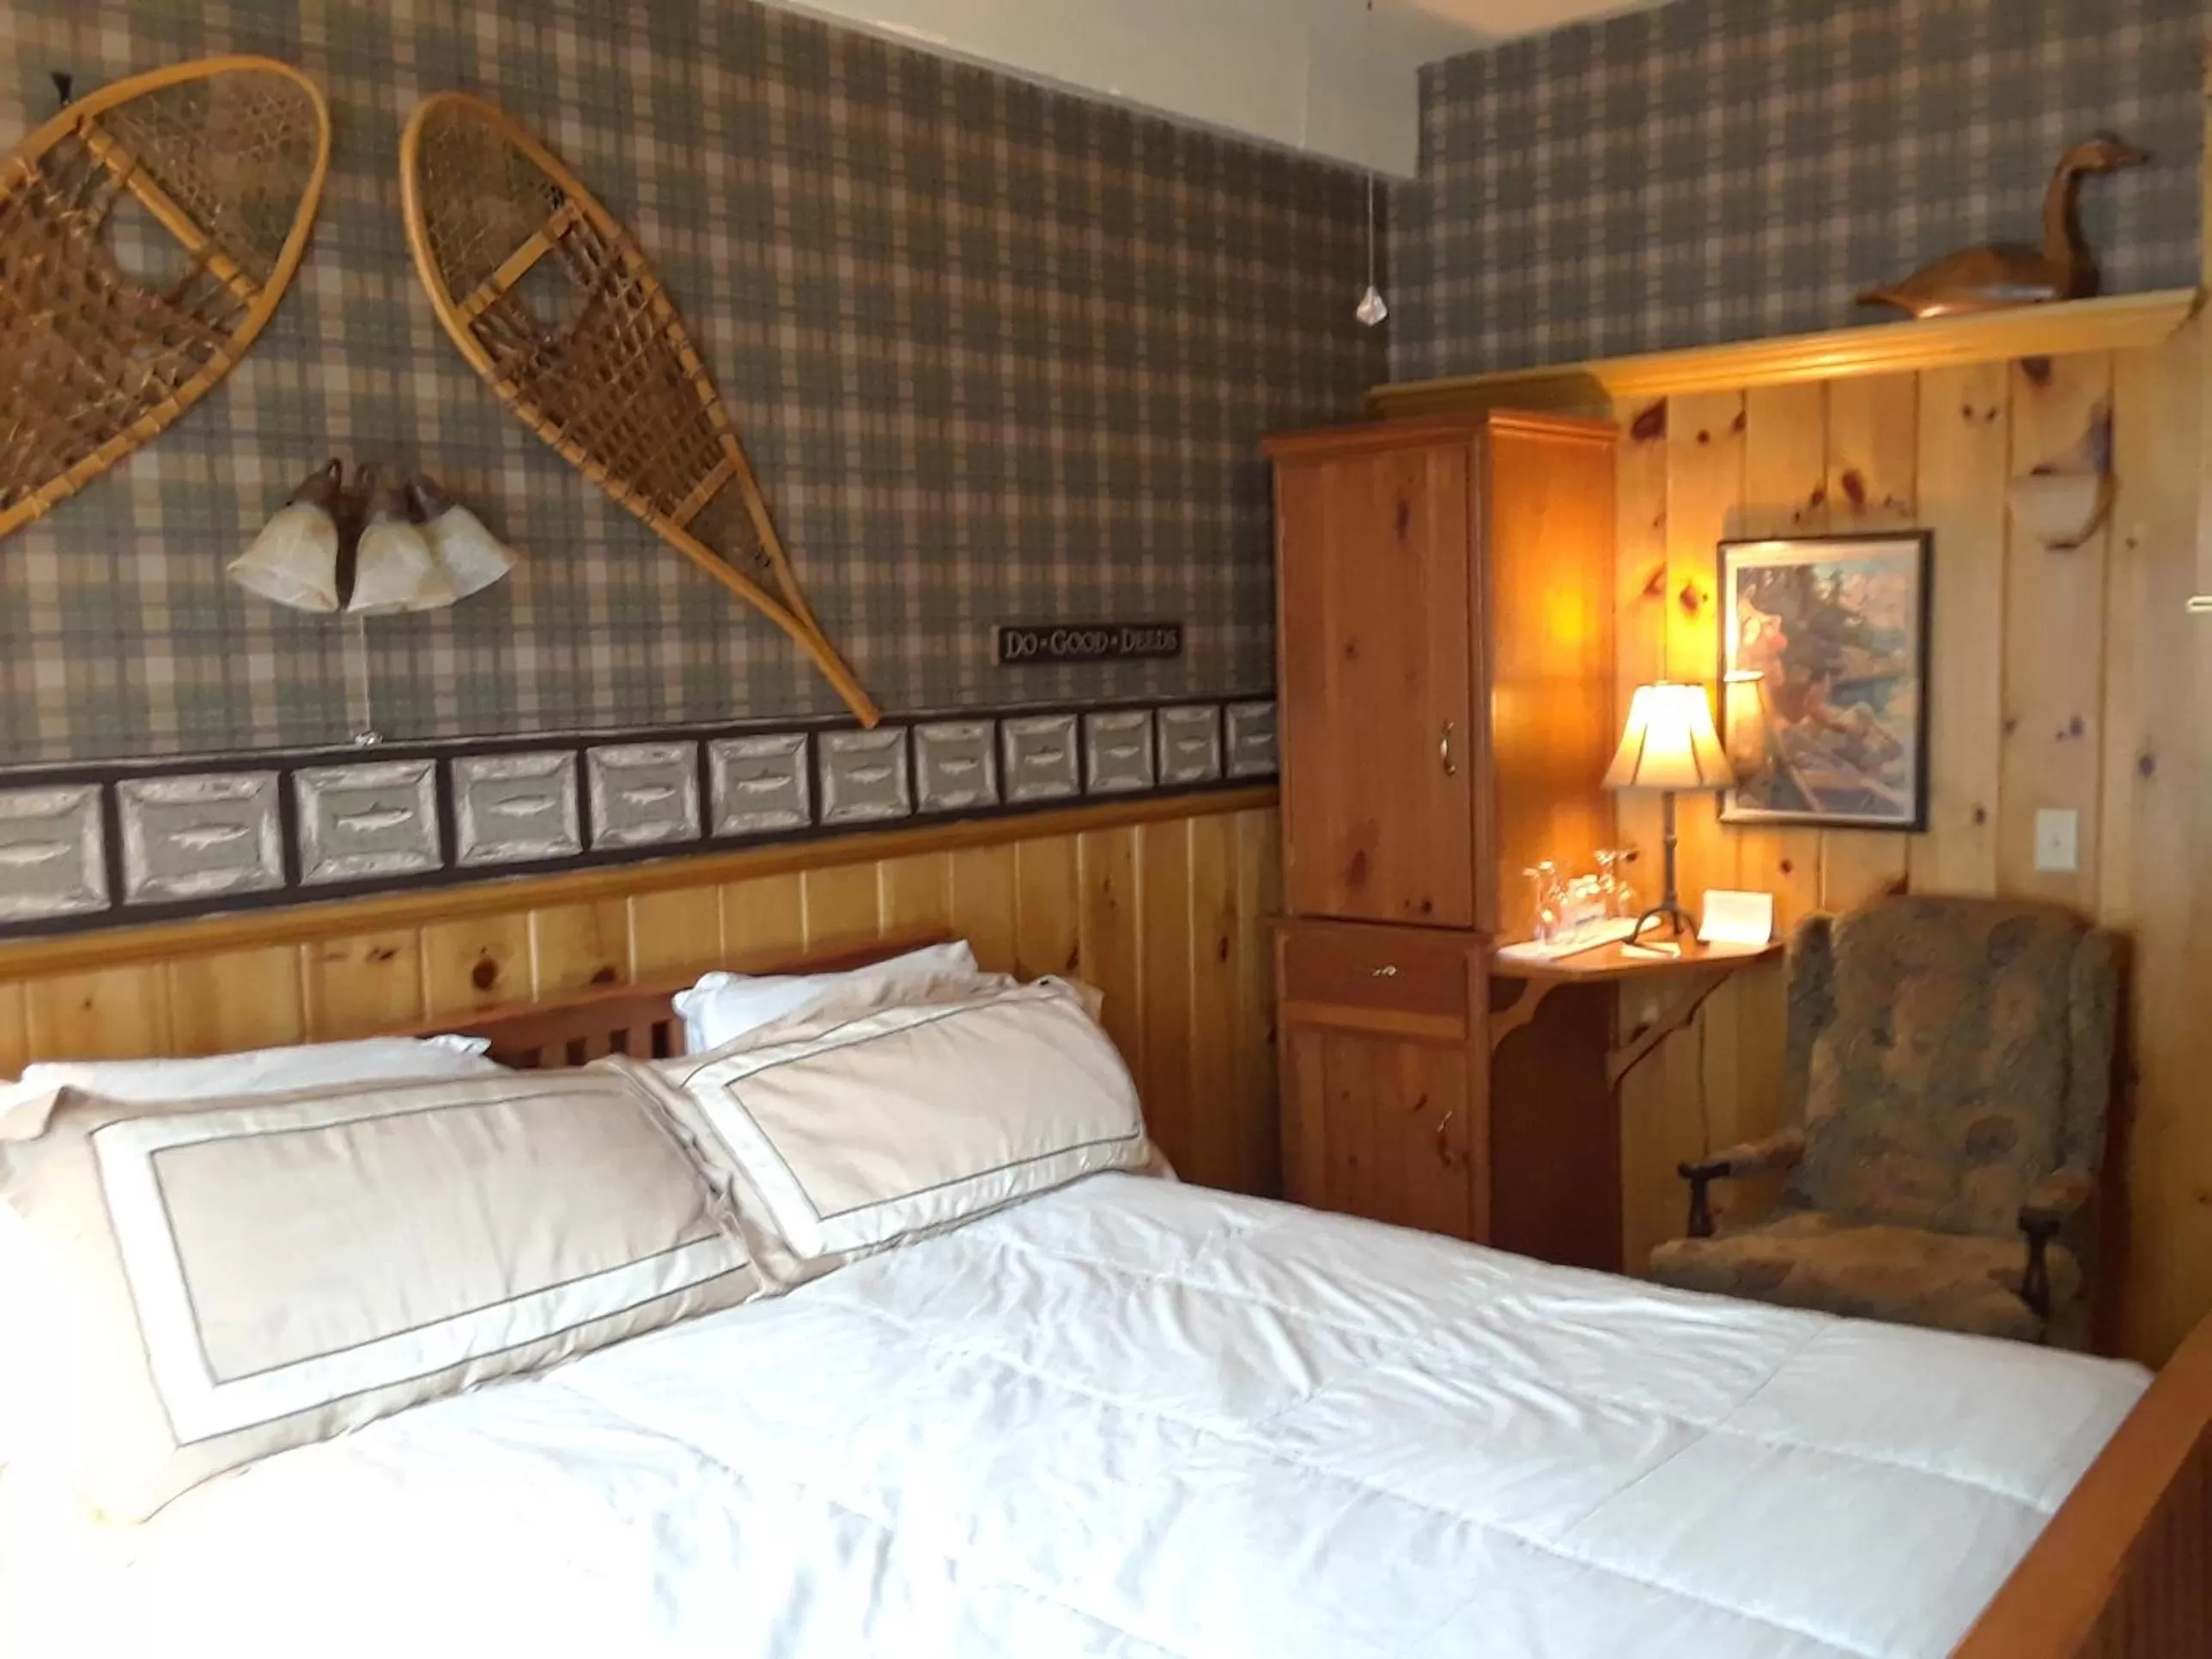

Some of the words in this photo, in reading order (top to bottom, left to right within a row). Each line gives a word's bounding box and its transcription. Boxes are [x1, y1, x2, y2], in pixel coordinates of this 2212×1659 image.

[1006, 630, 1038, 659] DO
[1050, 629, 1109, 655] GOOD
[1121, 628, 1178, 653] DEEDS
